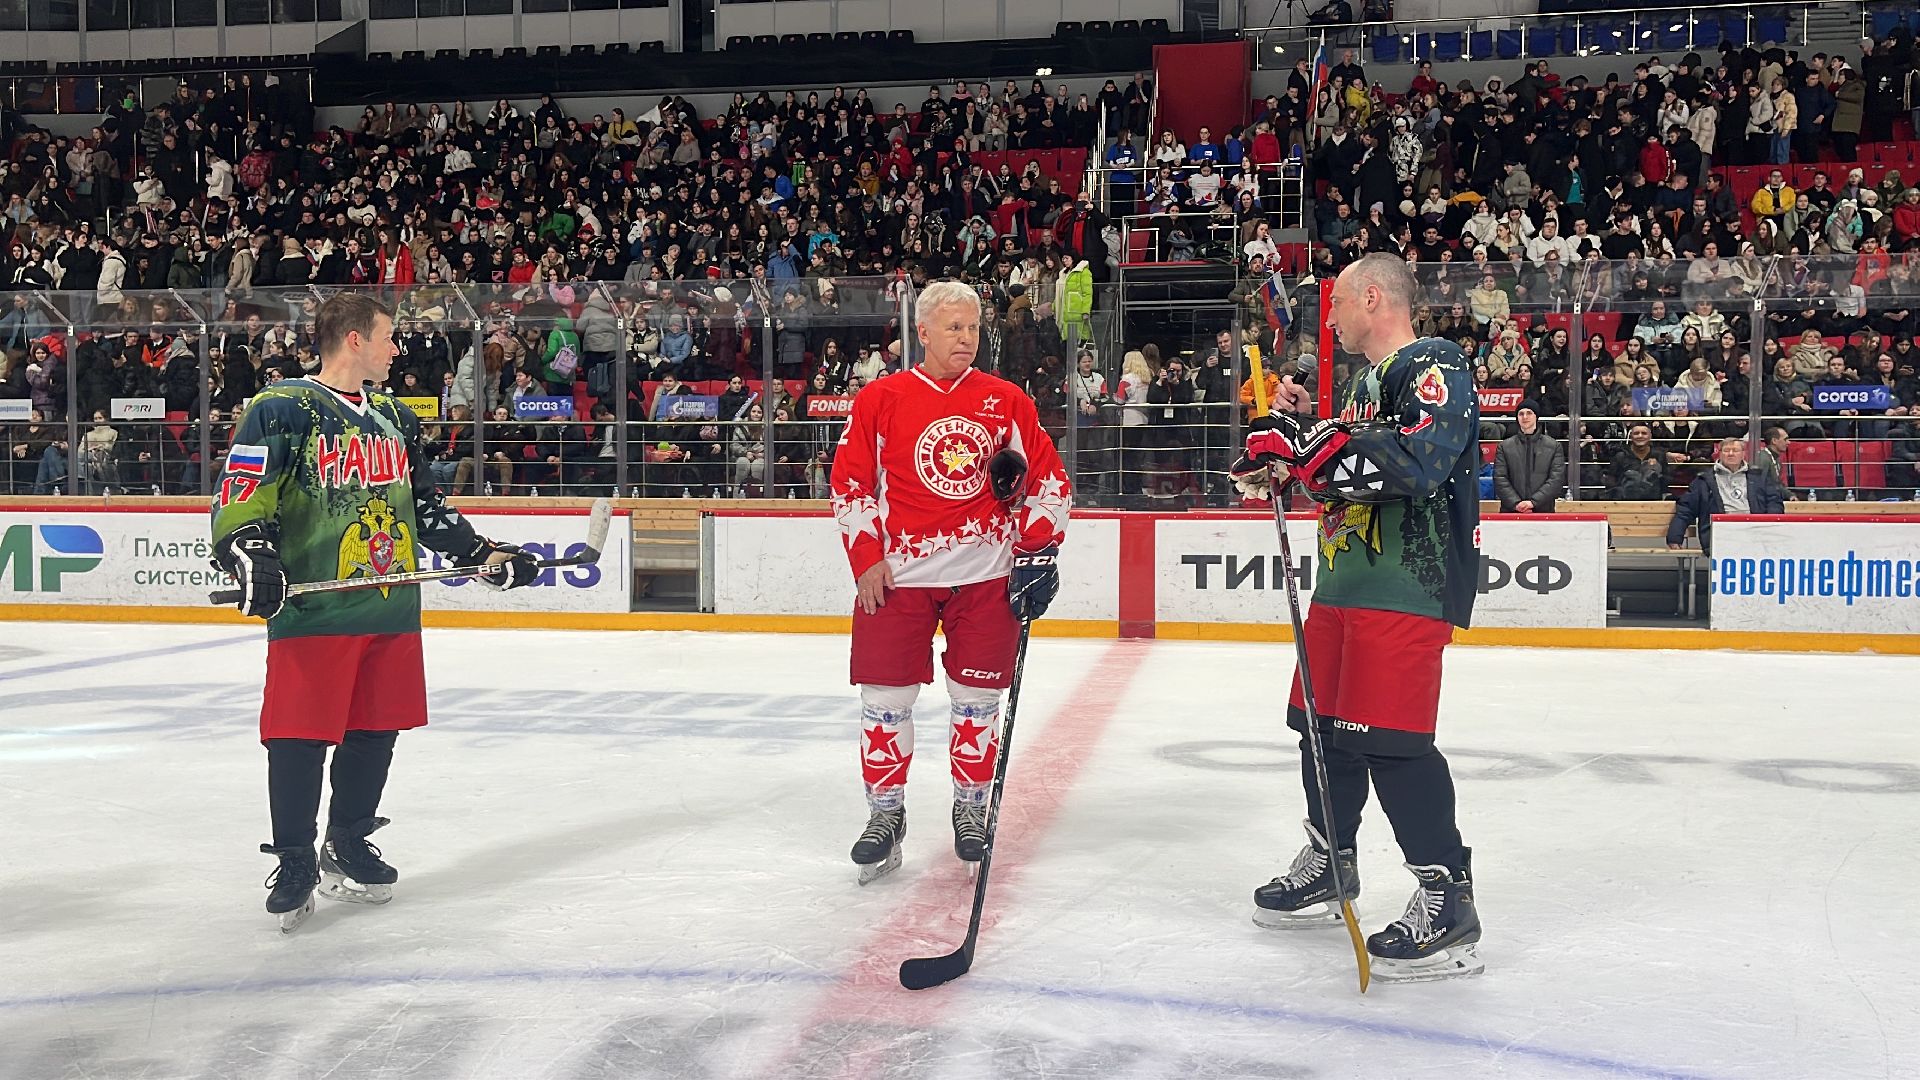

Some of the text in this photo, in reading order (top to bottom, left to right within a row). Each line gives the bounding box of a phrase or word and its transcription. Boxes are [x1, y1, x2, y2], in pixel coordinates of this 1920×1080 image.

[921, 421, 988, 452] ЛЕГЕНДЫ
[317, 433, 413, 489] НАШИ
[219, 476, 262, 508] 17
[134, 571, 236, 586] система
[961, 668, 1002, 680] CCM
